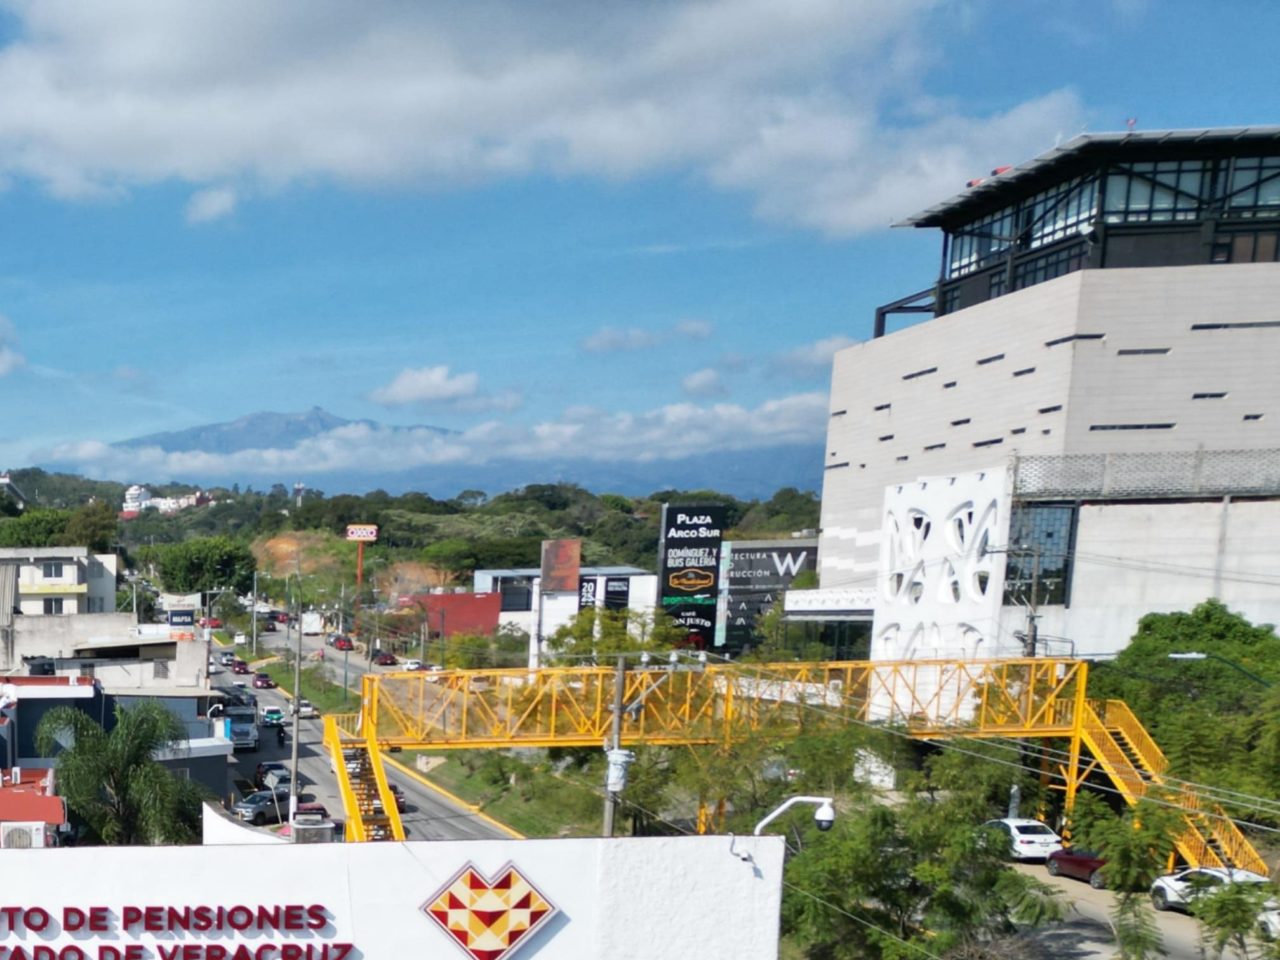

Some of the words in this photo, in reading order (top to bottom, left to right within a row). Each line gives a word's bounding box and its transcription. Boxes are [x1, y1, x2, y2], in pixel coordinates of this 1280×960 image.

[348, 529, 377, 538] OXXO
[771, 551, 808, 577] W
[582, 582, 595, 592] 20
[63, 907, 109, 931] DE
[122, 904, 327, 931] PENSIONES
